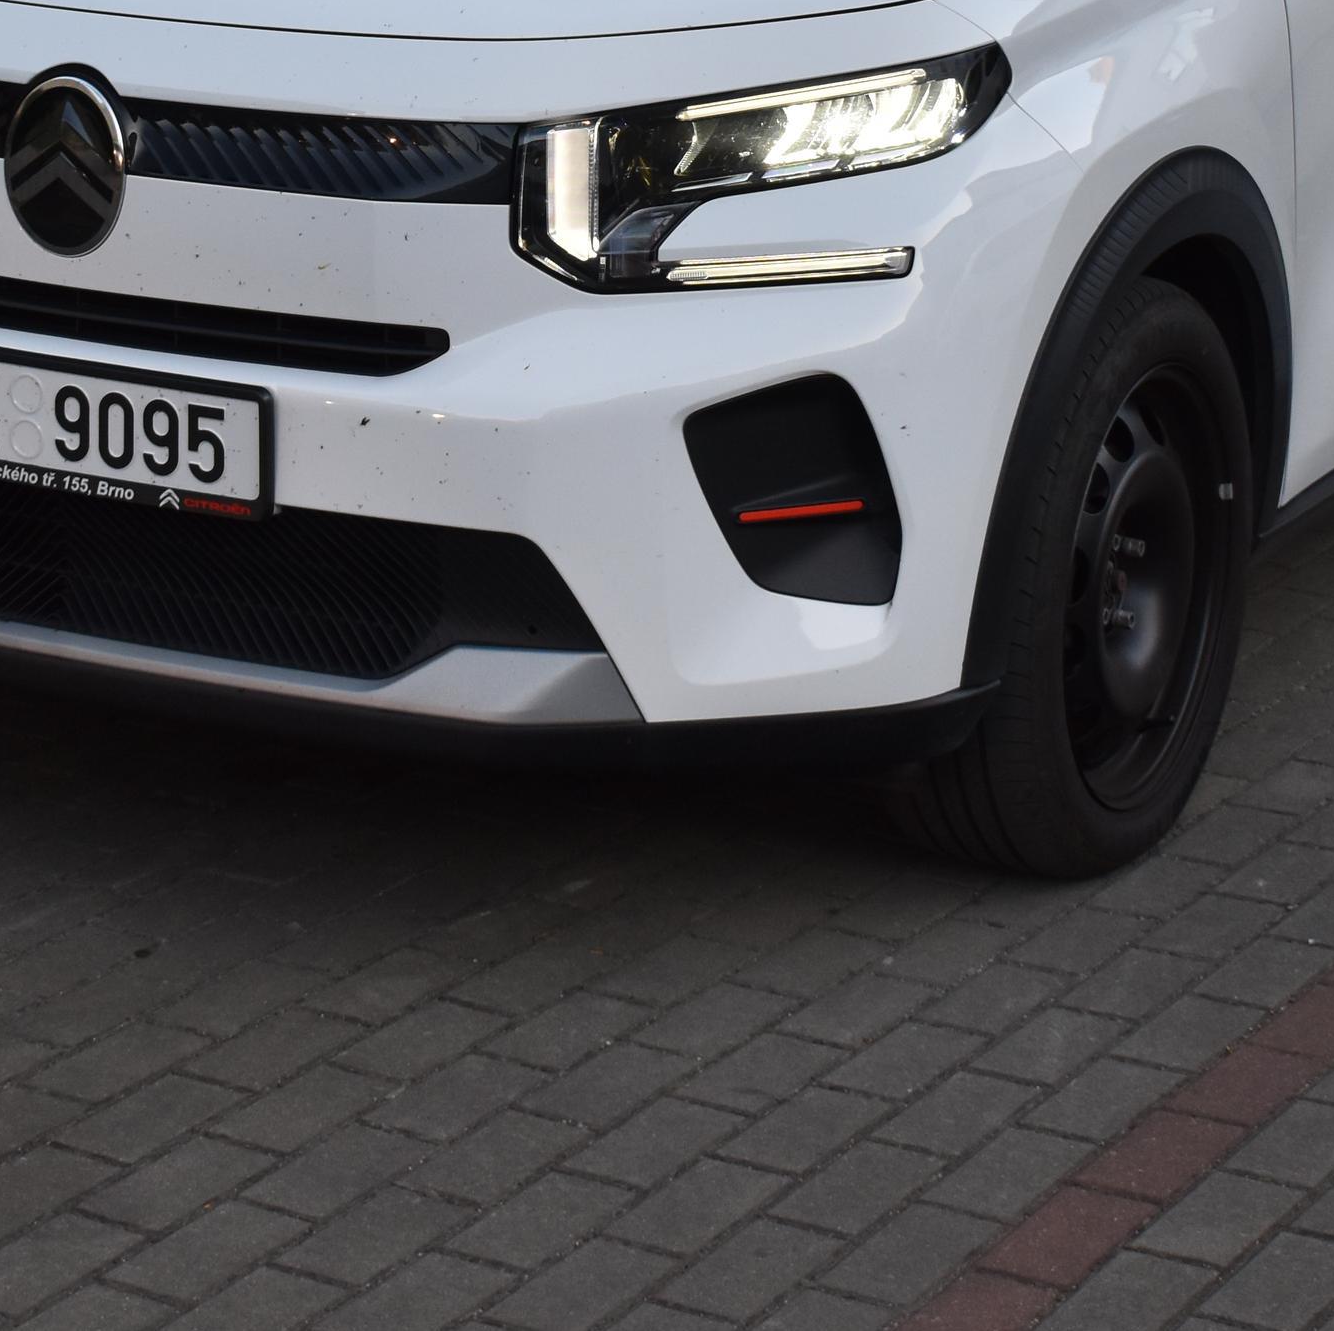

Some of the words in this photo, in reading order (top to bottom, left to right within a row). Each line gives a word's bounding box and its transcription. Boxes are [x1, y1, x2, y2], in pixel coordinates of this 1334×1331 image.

[53, 384, 226, 484] 9095
[42, 472, 57, 488] tř.
[62, 475, 92, 496] 155,
[96, 480, 135, 501] Brno
